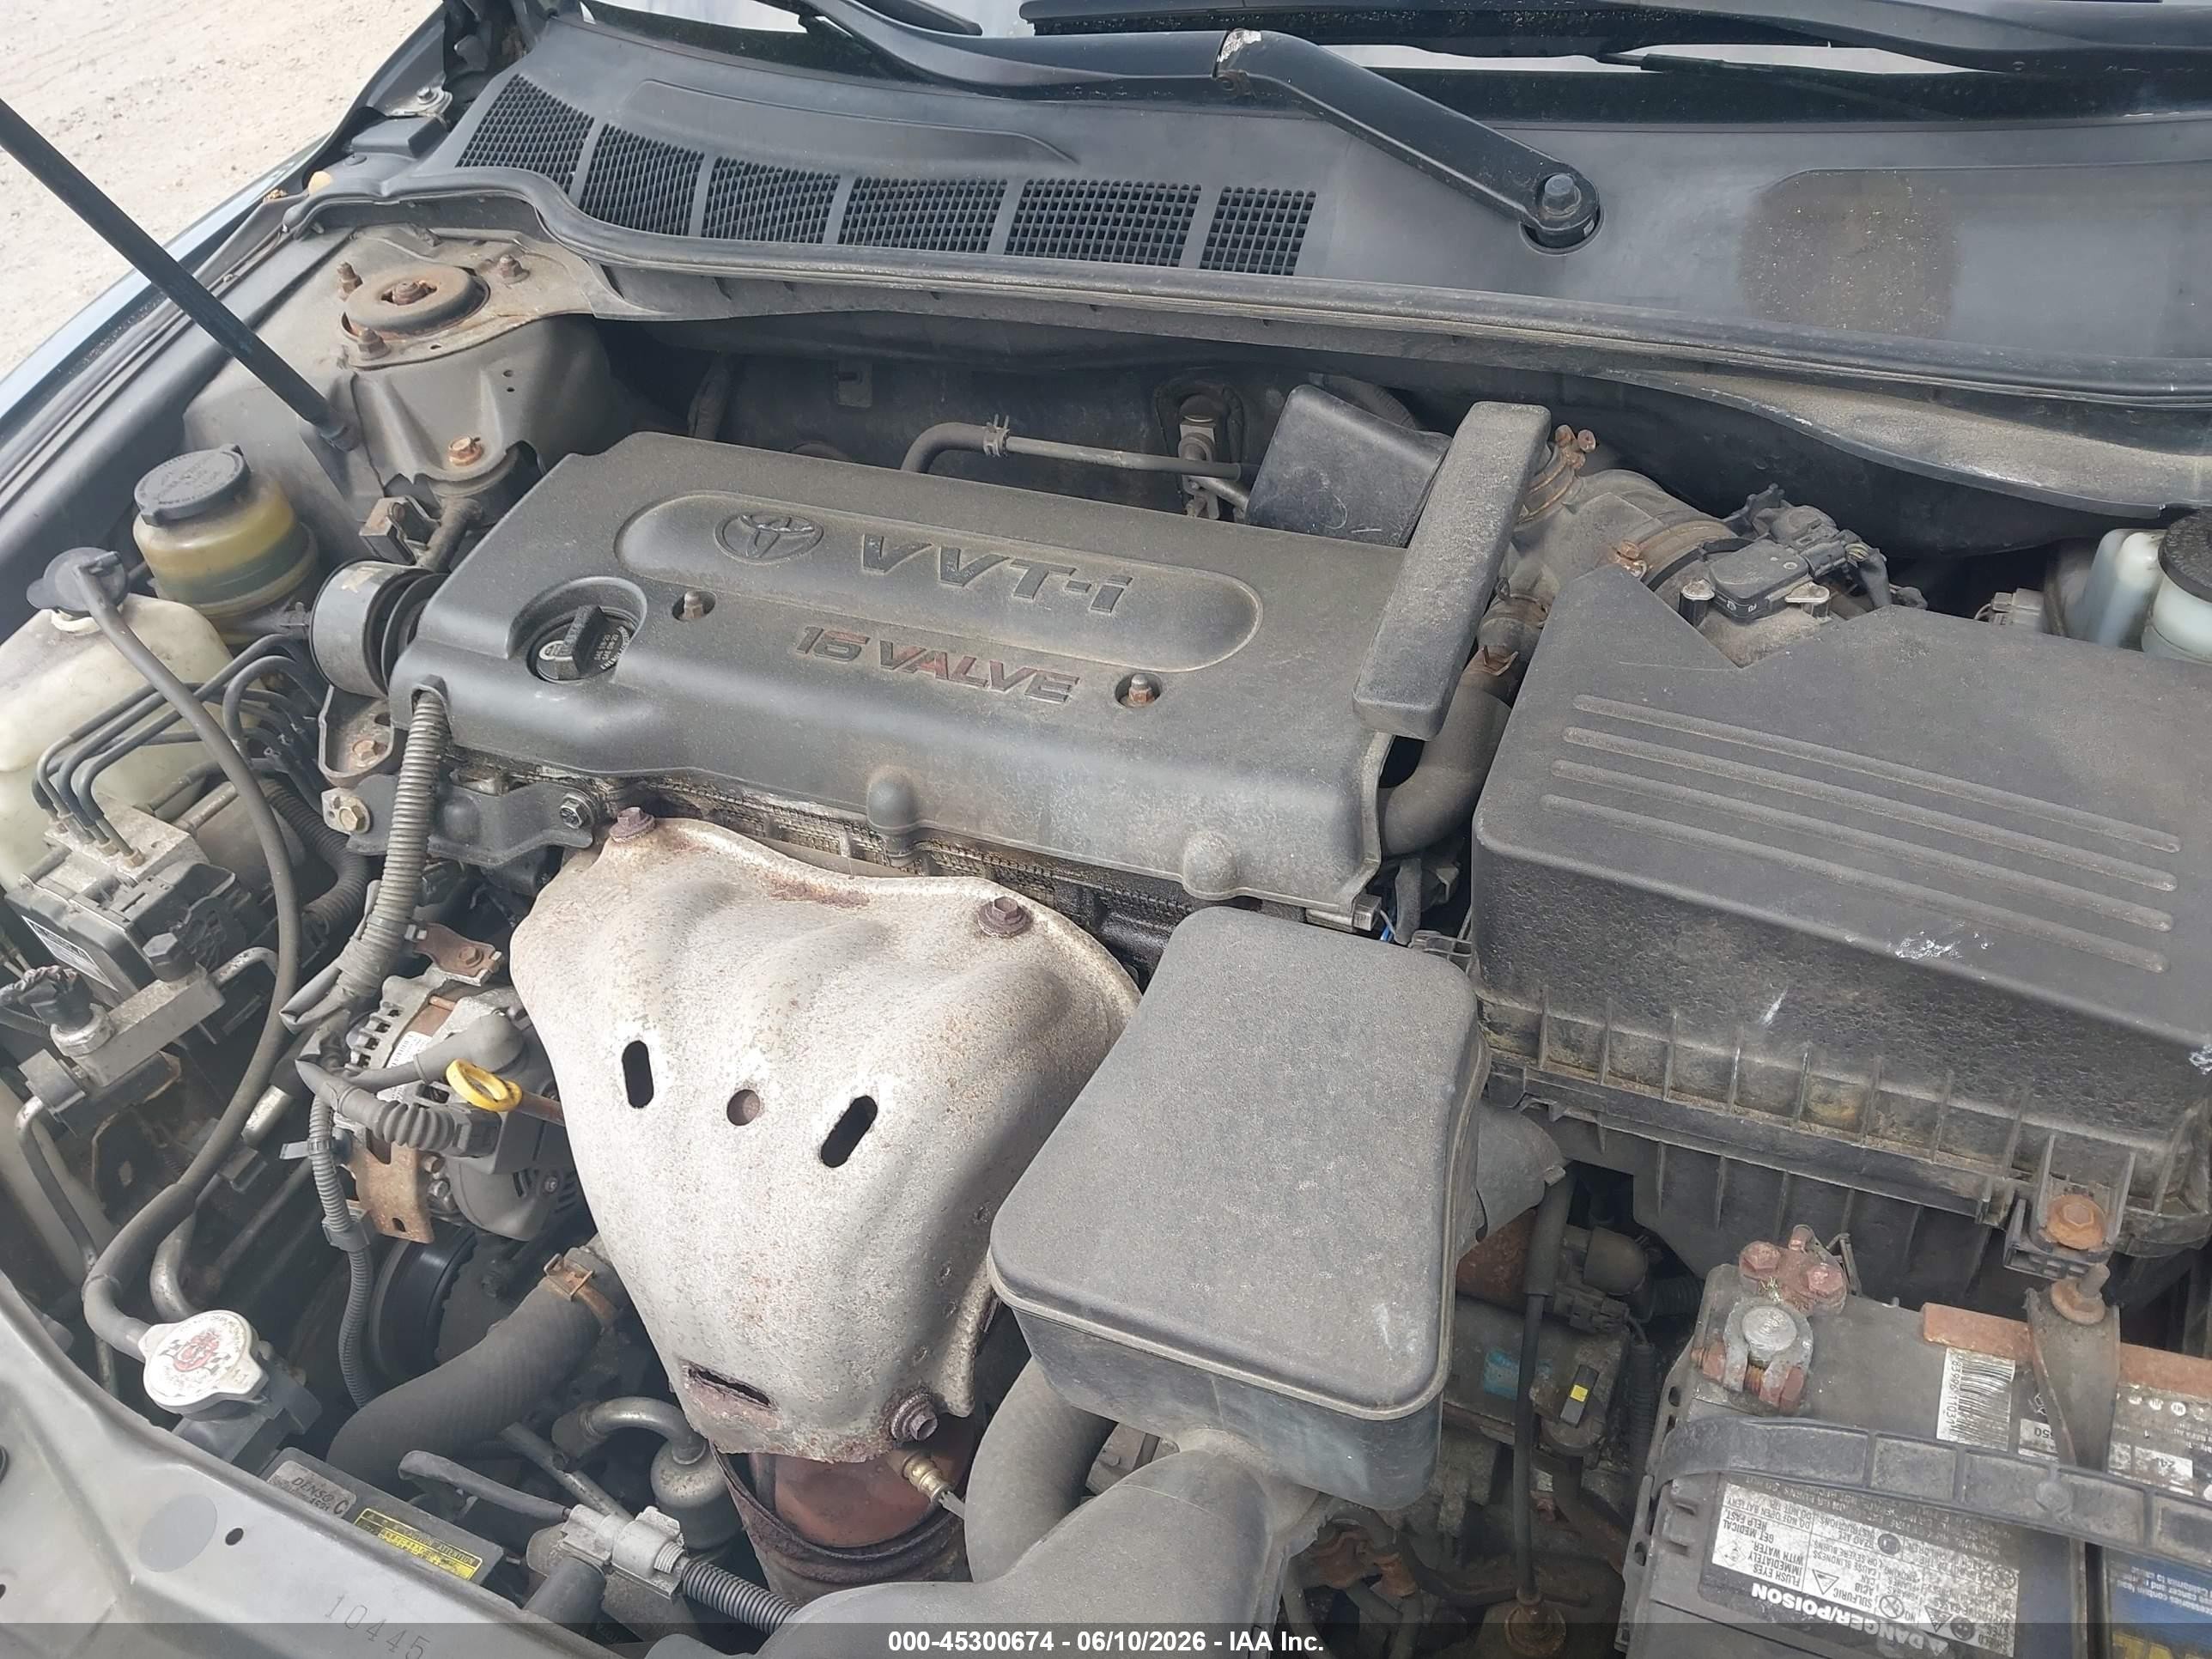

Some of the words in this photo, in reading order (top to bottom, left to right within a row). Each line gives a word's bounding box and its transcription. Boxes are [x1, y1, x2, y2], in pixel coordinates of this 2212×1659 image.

[861, 532, 1133, 615] VVT-i
[795, 625, 870, 663] 16
[878, 639, 1080, 704] VALVE
[291, 1474, 334, 1504] DENSO
[331, 1496, 349, 1517] C
[1721, 1519, 1757, 1538] MEDICAL
[1746, 1516, 1767, 1531] HELP
[1759, 1530, 1774, 1543] GET
[1749, 1540, 1781, 1558] WATER.
[1781, 1550, 1803, 1565] WITH
[1747, 1550, 1802, 1576] IMMEDIATELY
[1752, 1563, 1772, 1577] EYES
[1774, 1571, 1800, 1586] FLUSH
[1832, 1587, 1873, 1607] SULFURIC
[1749, 1582, 1925, 1647] DANGER/POISON
[323, 1593, 430, 1659] 10445
